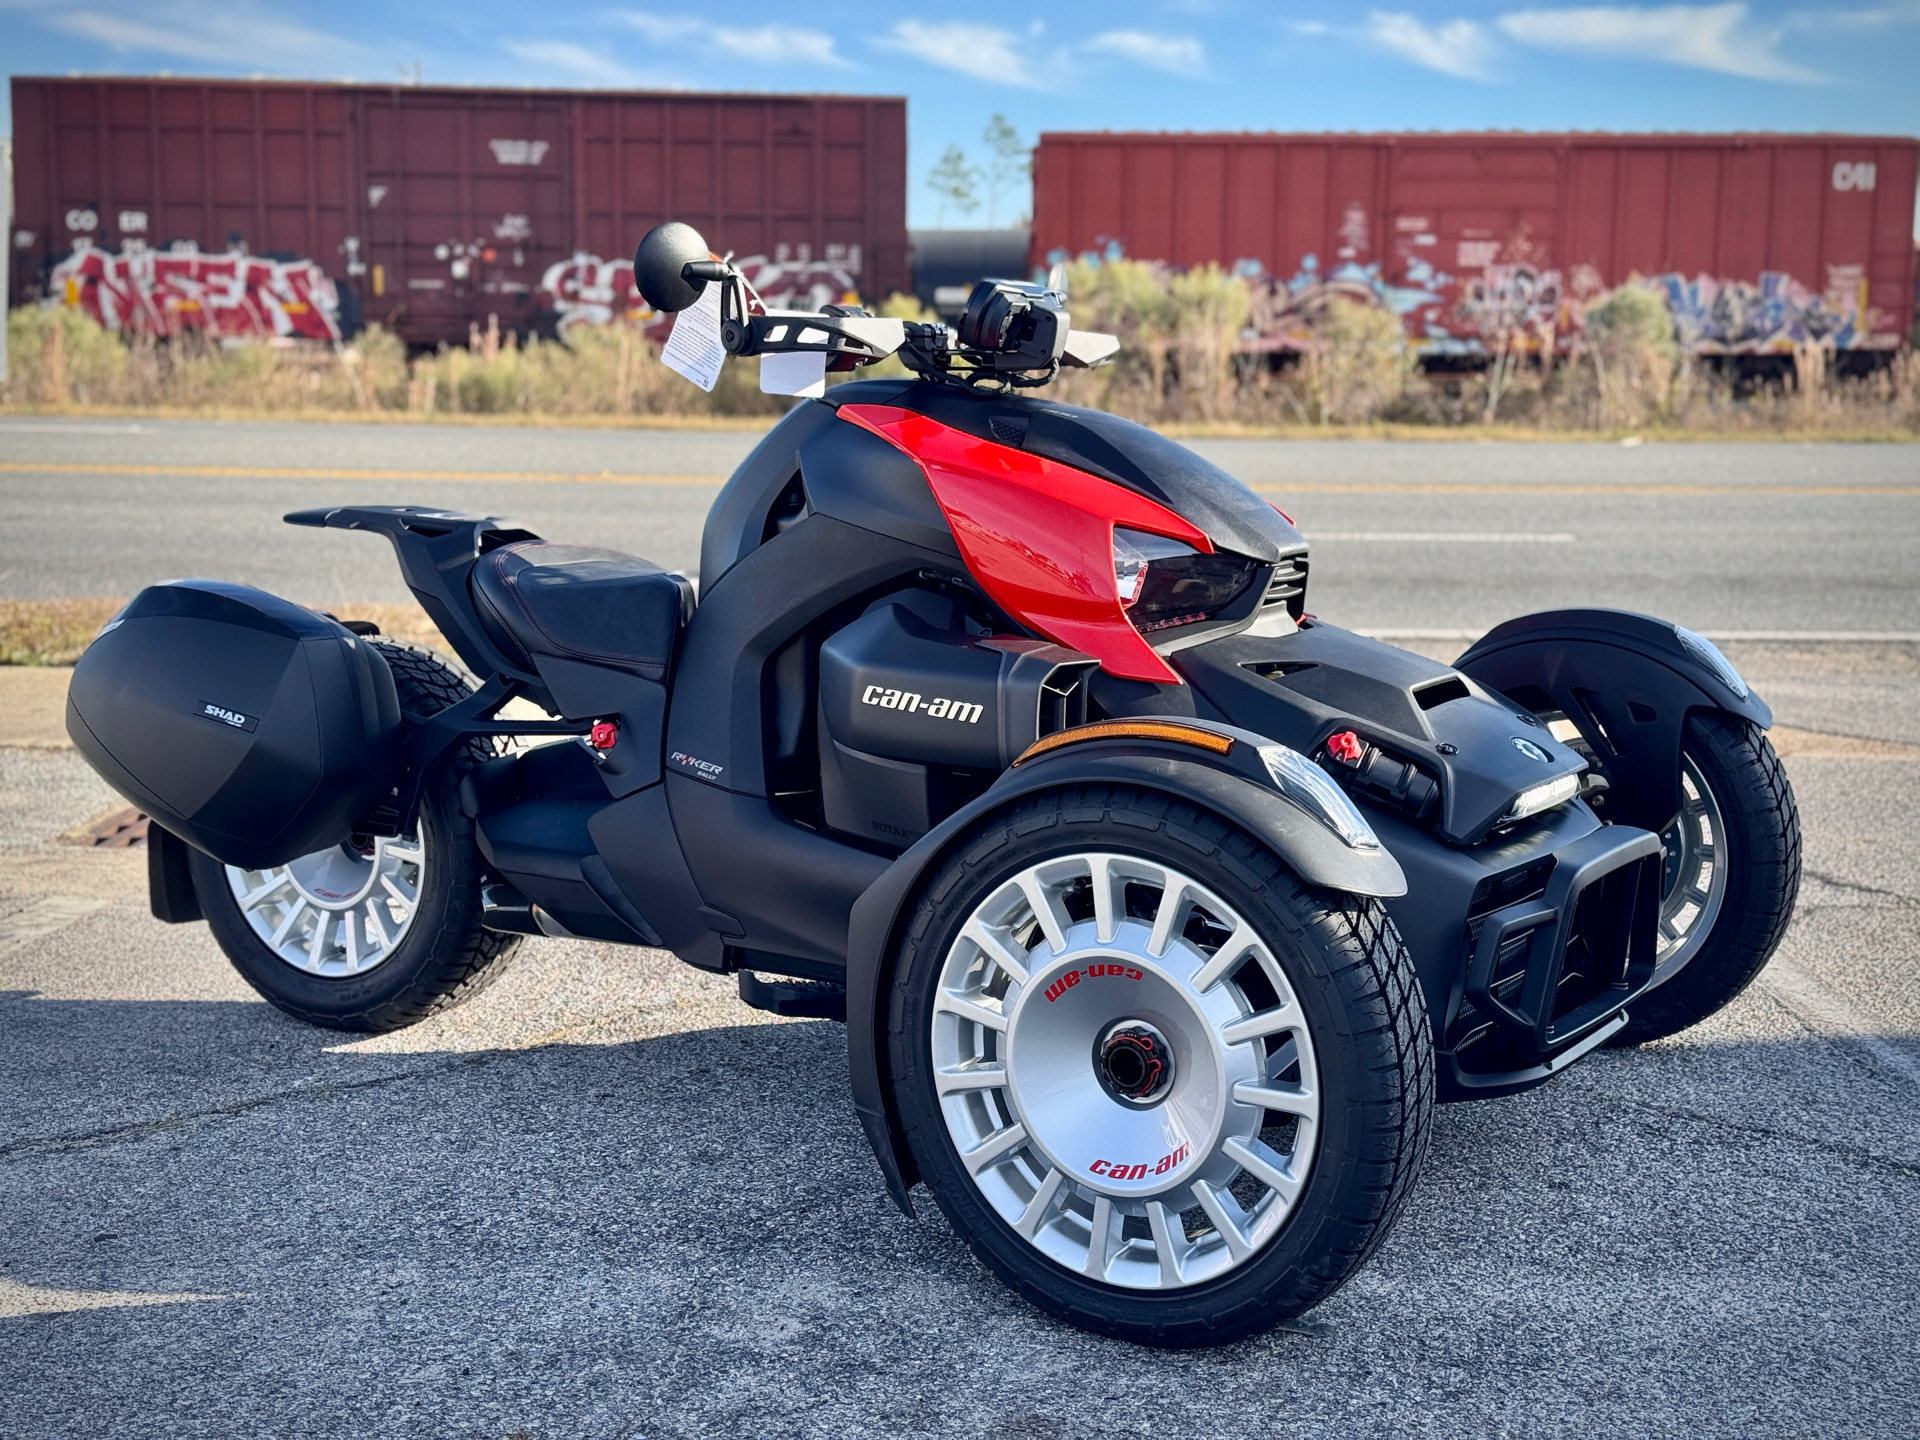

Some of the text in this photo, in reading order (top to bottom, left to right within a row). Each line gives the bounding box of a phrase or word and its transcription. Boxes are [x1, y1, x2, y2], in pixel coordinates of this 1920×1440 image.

[204, 704, 246, 725] SHAD
[862, 685, 984, 724] can-am
[670, 751, 724, 775] RYKER
[697, 770, 717, 781] RALLY
[872, 820, 910, 839] ROTAX
[1044, 964, 1143, 1003] can-am
[1089, 1140, 1190, 1180] can-am
